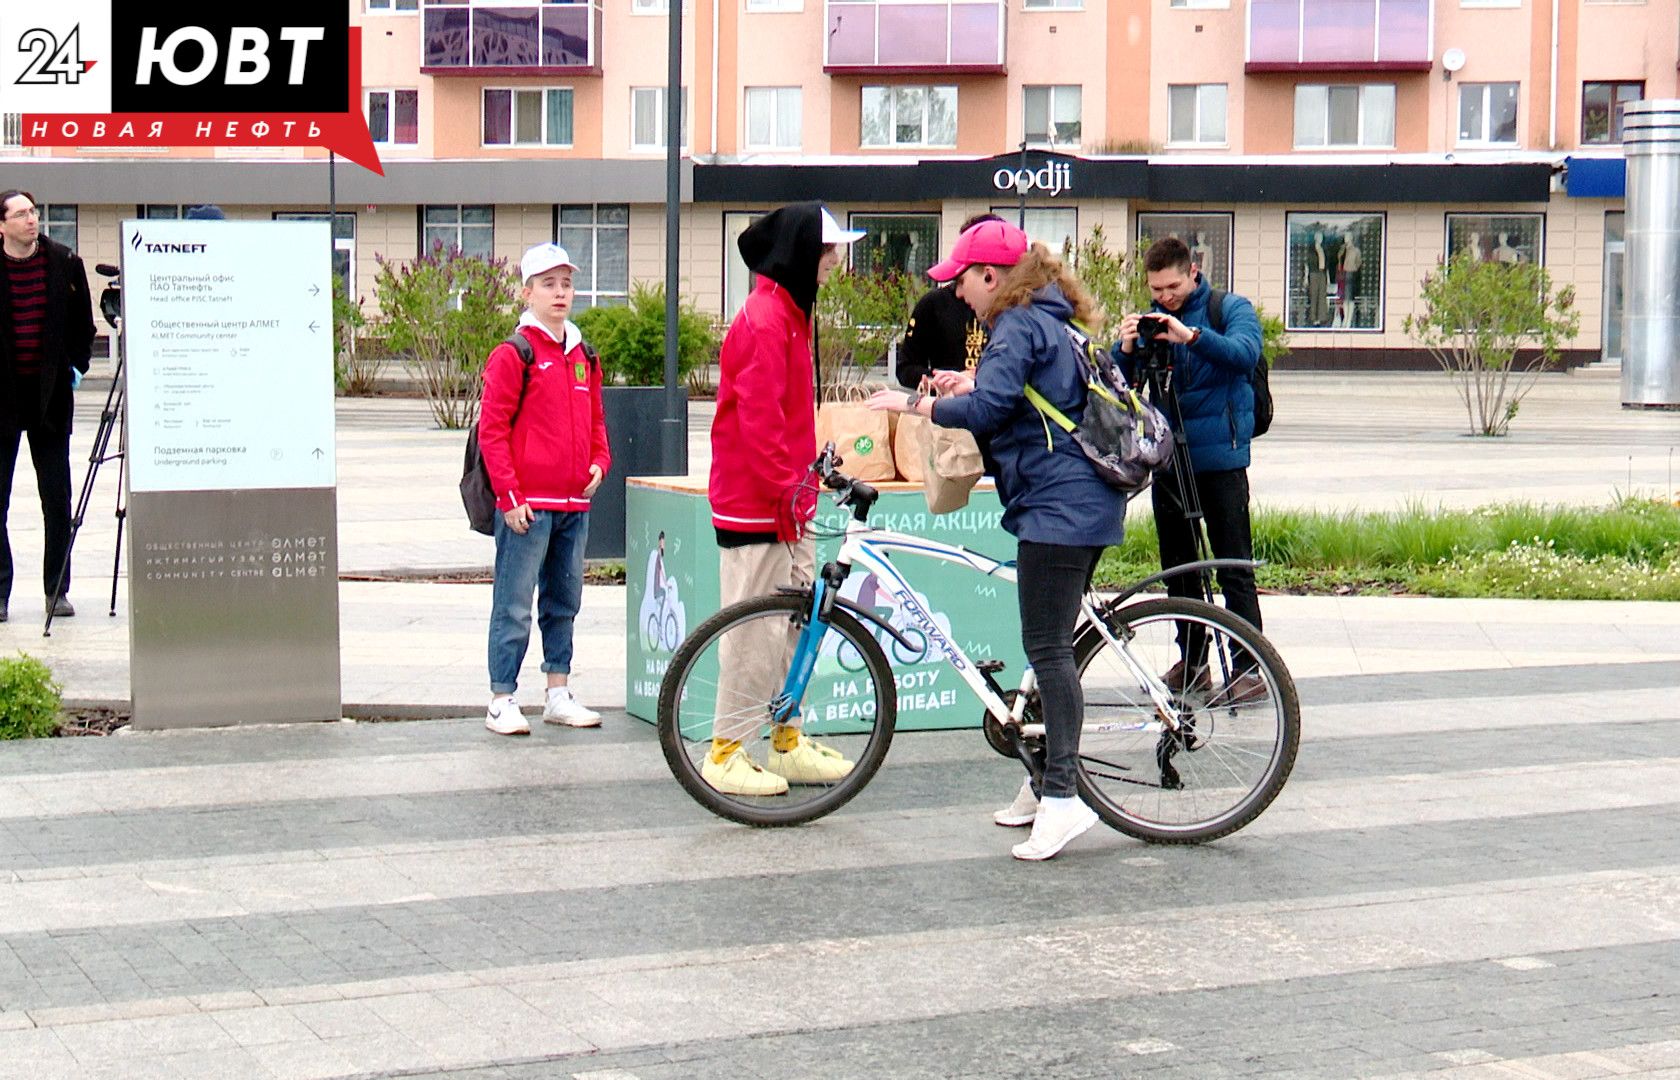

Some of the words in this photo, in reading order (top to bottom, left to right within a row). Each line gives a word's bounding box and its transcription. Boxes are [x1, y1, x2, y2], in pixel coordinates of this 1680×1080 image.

[993, 160, 1072, 197] oodji
[145, 243, 207, 253] TATNEFT
[150, 273, 210, 283] Центральный
[212, 274, 234, 283] офис
[150, 283, 170, 291] ПАО
[172, 283, 213, 292] Татнефть
[150, 319, 219, 329] Общественный
[221, 321, 247, 329] центр
[249, 319, 280, 327] АЛМЕТ
[176, 332, 214, 341] Community
[154, 446, 203, 456] Подземная
[205, 446, 247, 455] парковка
[155, 458, 200, 466] Underground
[201, 457, 227, 466] parking
[932, 511, 1003, 534] АКЦИЯ
[146, 570, 223, 580] COMMUNITY
[896, 590, 966, 671] FORWARD
[832, 682, 859, 698] НА
[866, 669, 940, 694] РБОТУ
